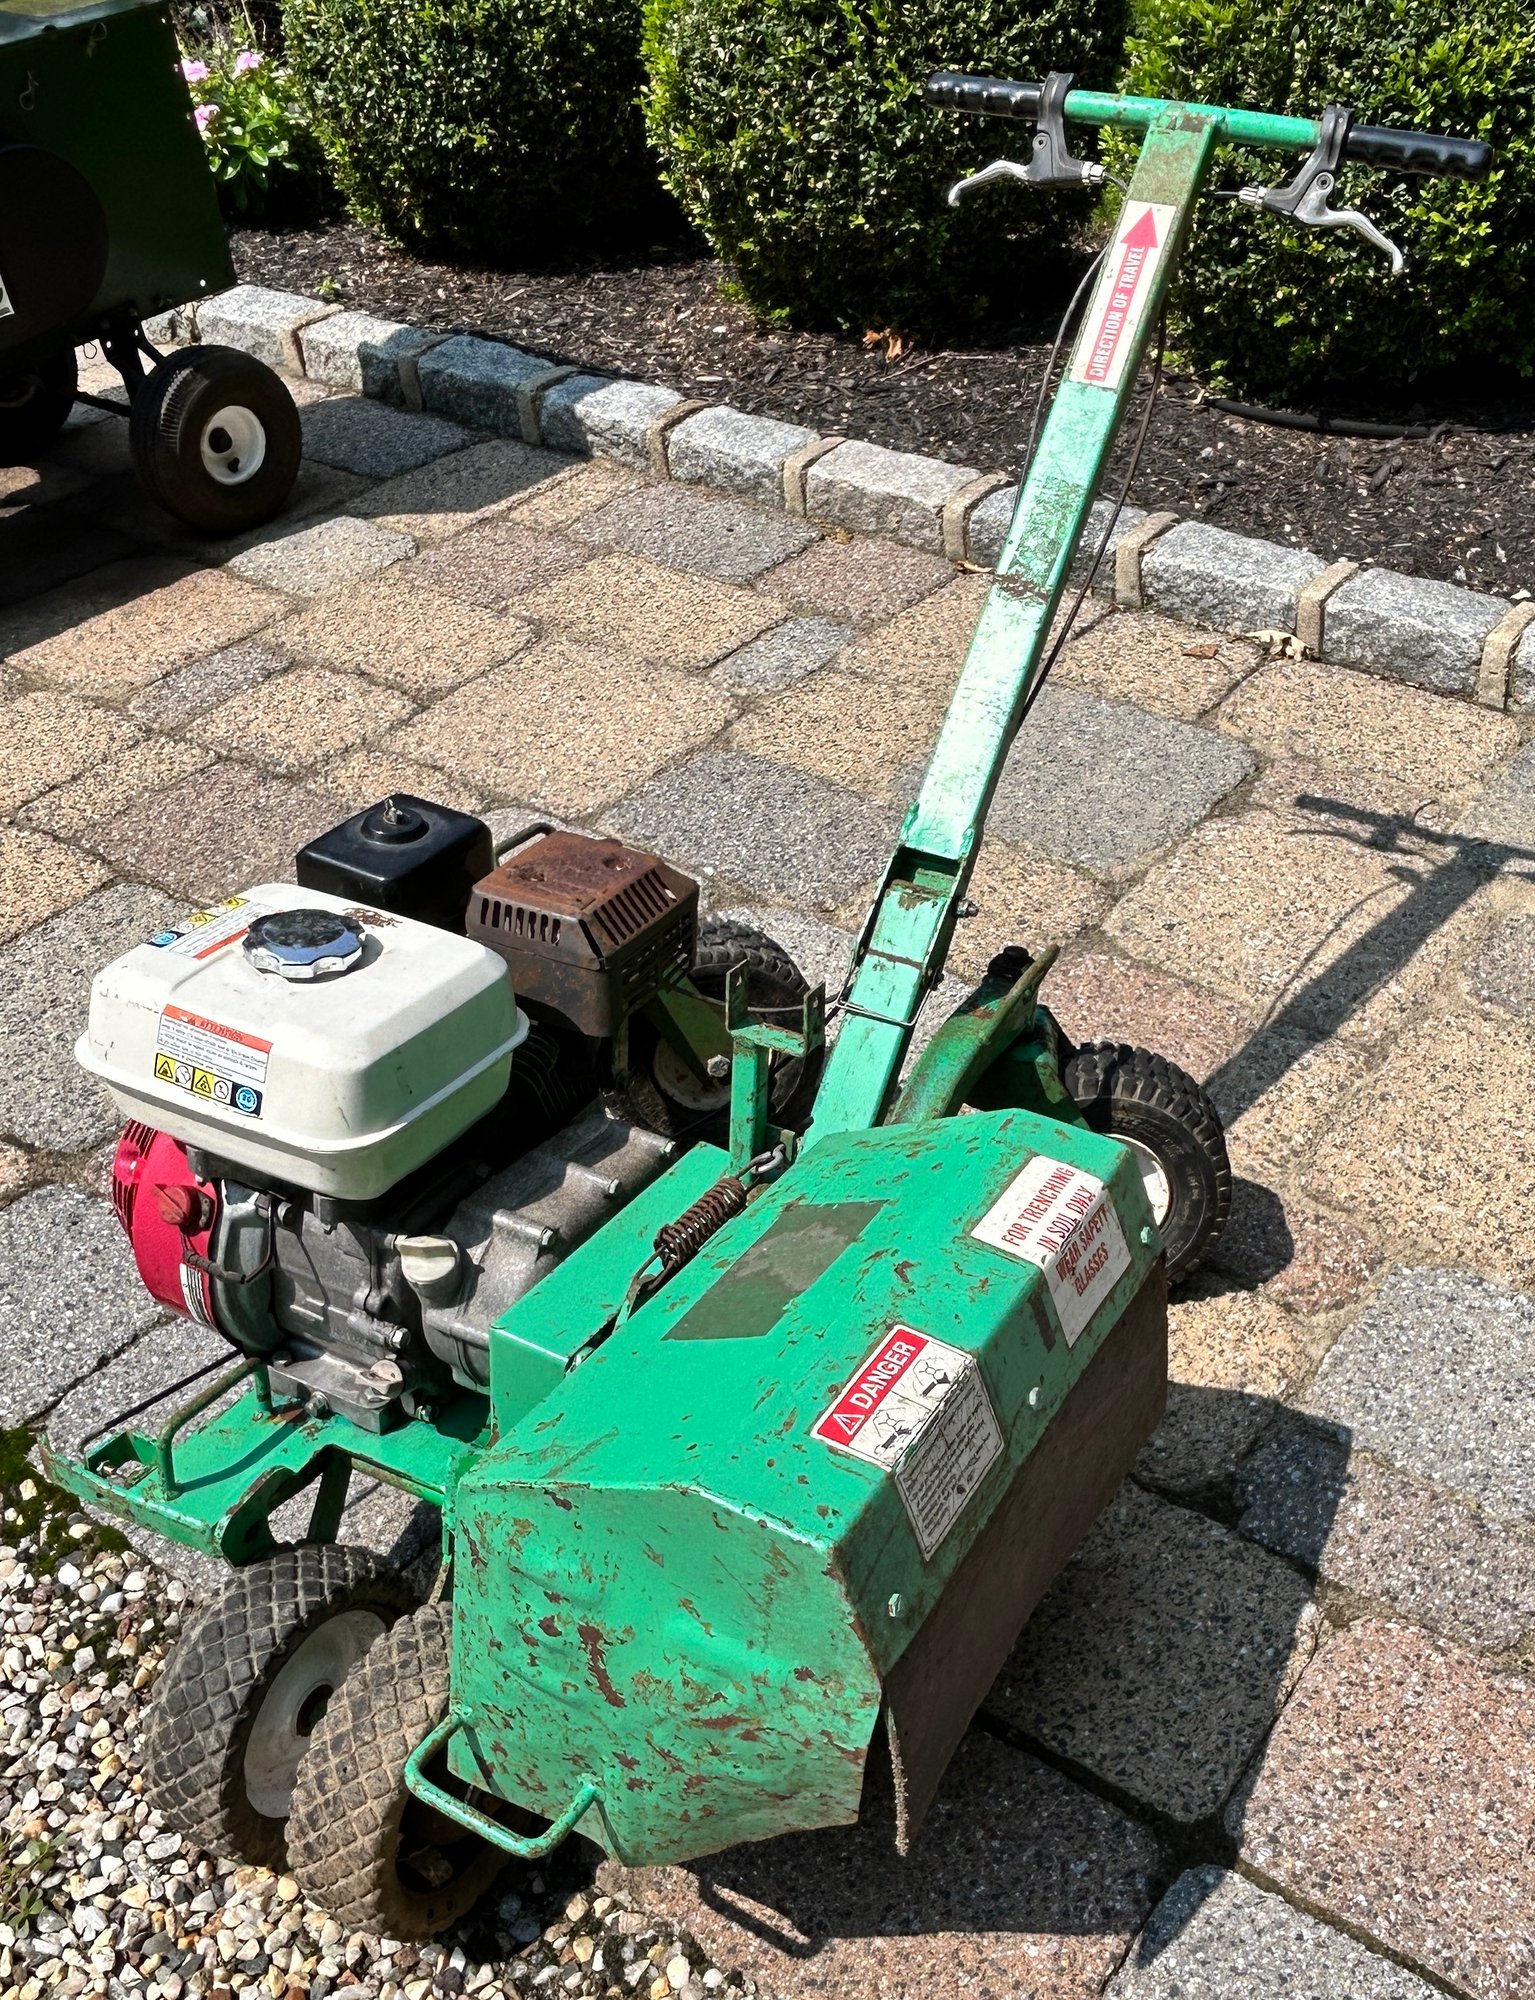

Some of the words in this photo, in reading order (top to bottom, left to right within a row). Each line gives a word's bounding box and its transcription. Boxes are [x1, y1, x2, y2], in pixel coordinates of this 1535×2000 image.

[1118, 246, 1146, 289] TRAVEL
[1115, 292, 1129, 309] OF
[1089, 311, 1124, 377] DIRECTION
[1001, 1222, 1033, 1247] FOR
[1018, 1167, 1076, 1224] TRENCHING
[1065, 1185, 1096, 1216] ONLY
[1037, 1235, 1060, 1254] IN
[1047, 1212, 1080, 1239] SOIL
[1055, 1241, 1082, 1282] WEAR
[1078, 1203, 1109, 1251] SAFETY
[1073, 1242, 1109, 1297] GLASSES
[849, 1341, 917, 1410] DANGER
